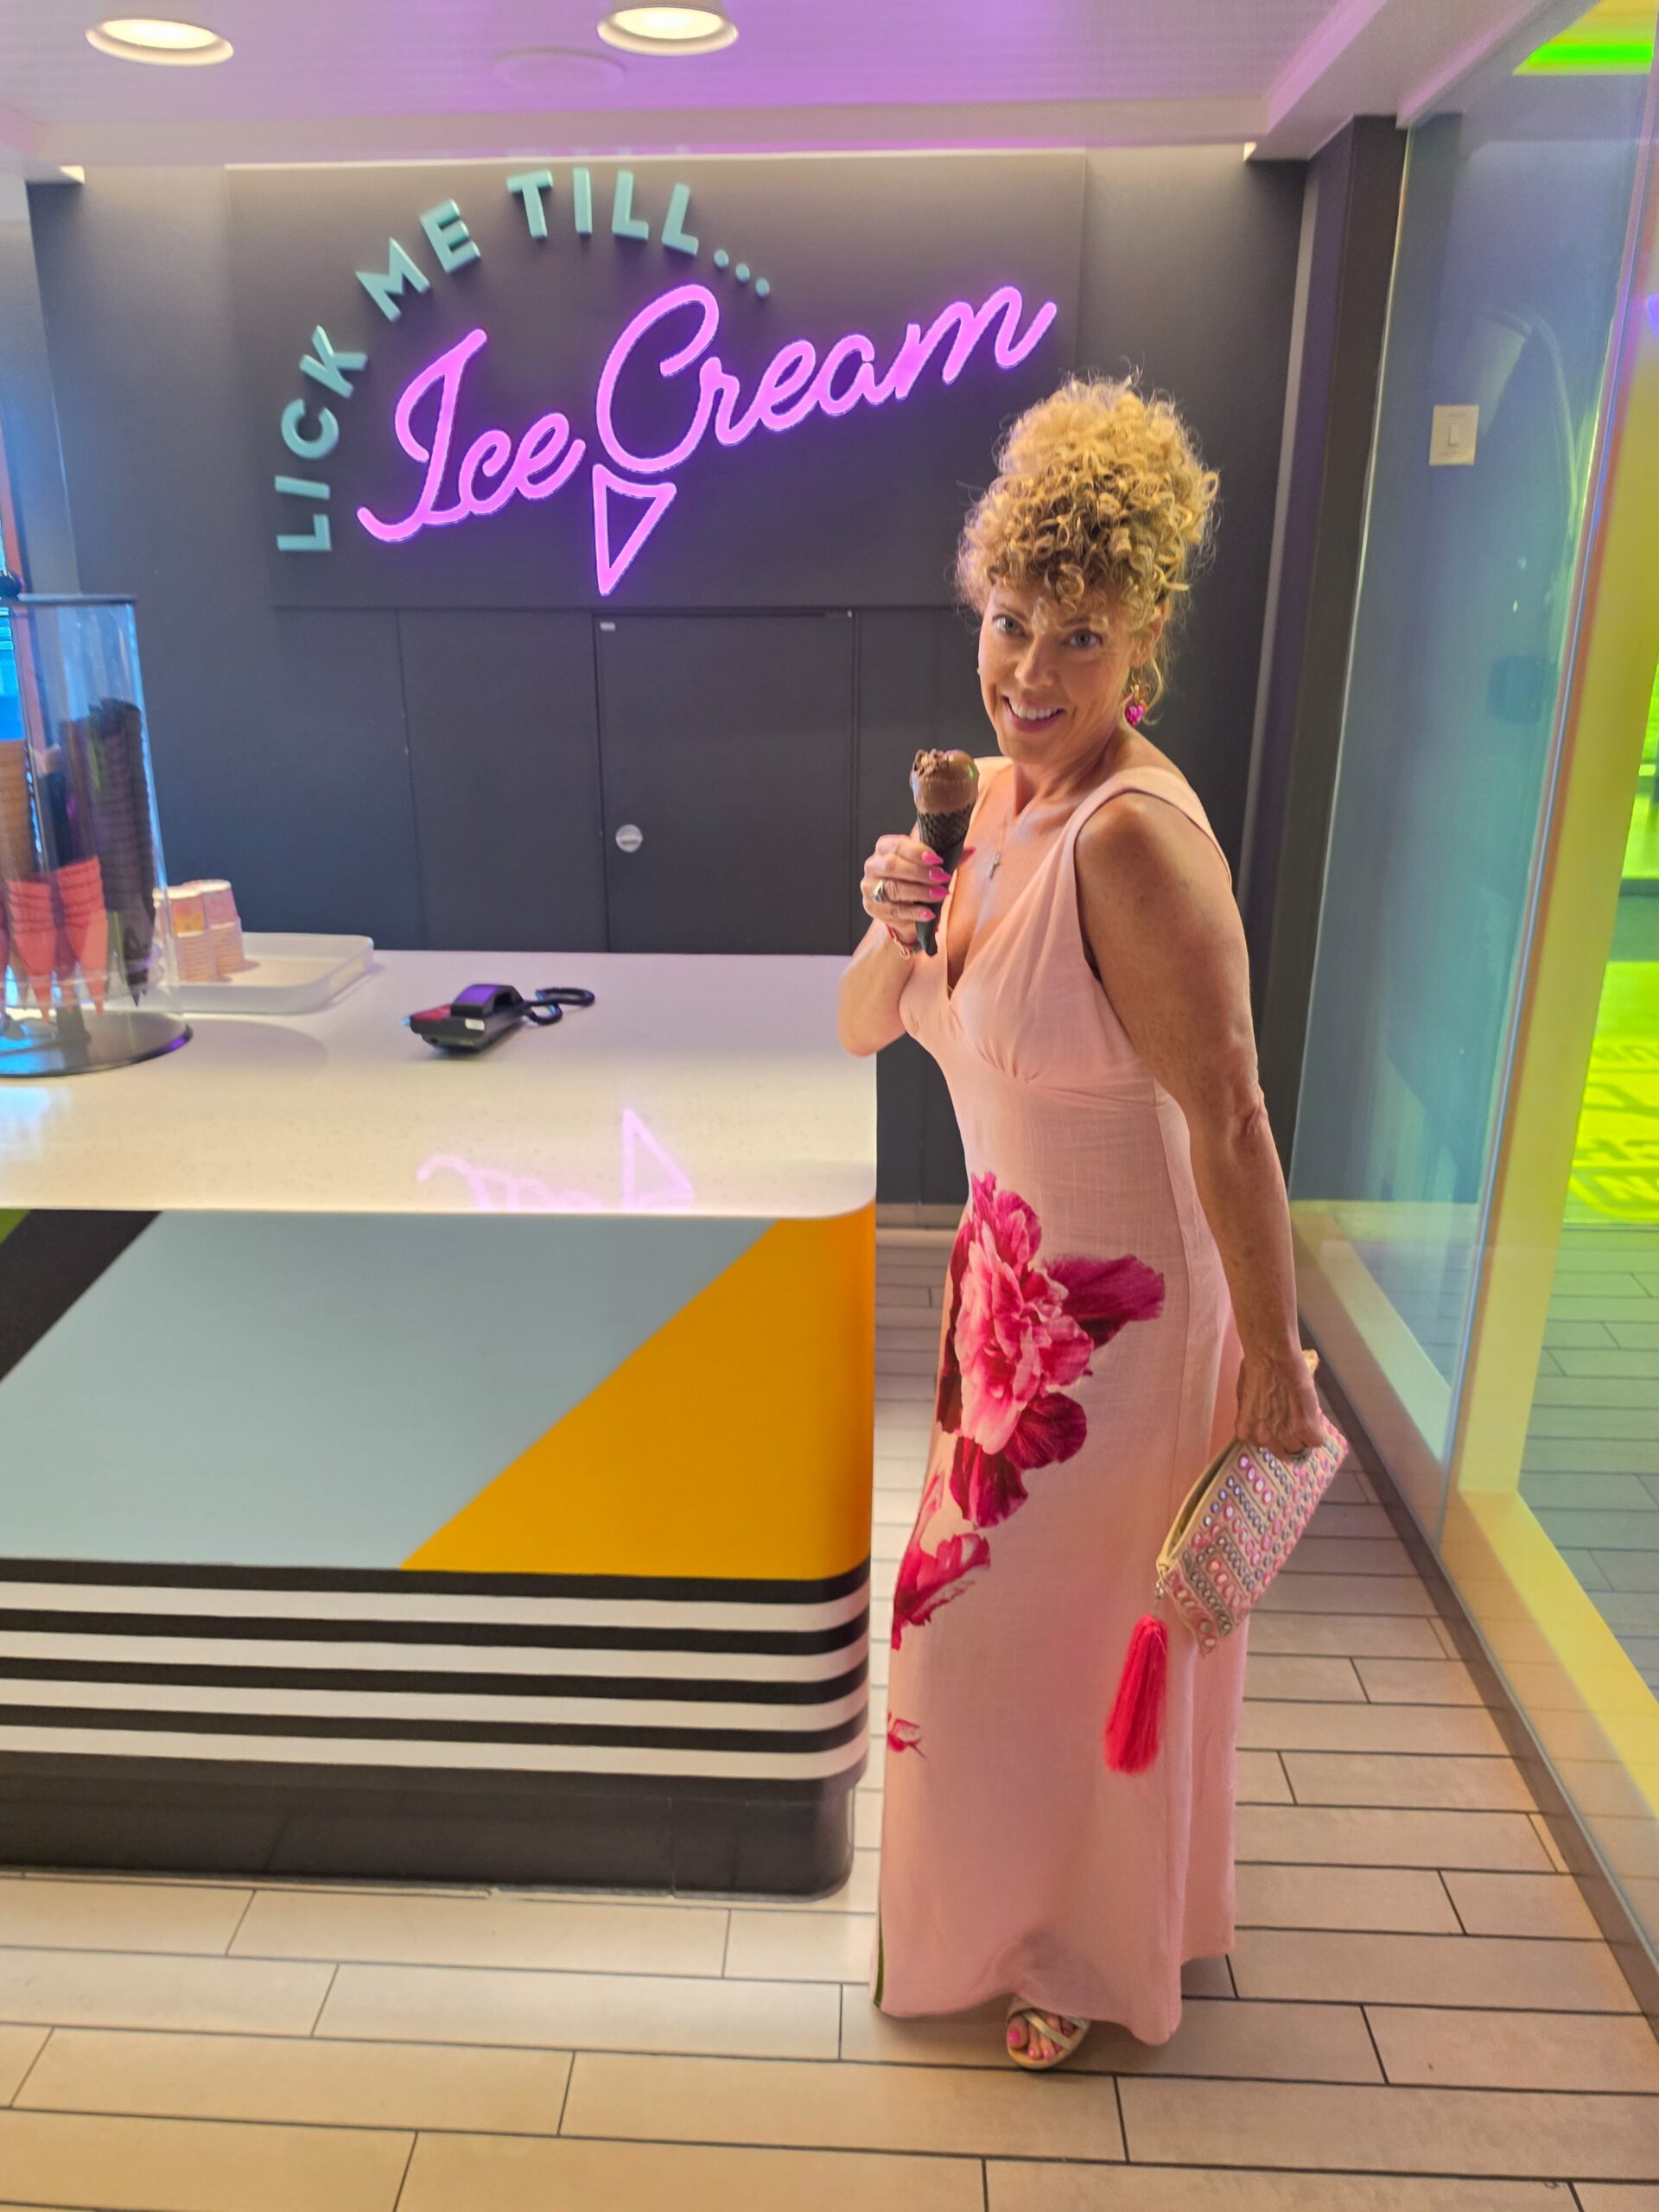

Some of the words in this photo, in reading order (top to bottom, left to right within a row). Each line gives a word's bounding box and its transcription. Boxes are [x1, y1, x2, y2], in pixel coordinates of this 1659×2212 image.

[275, 325, 368, 551] LICK
[355, 199, 480, 322] ME
[506, 167, 770, 297] TILL...
[357, 328, 587, 542] Ice
[595, 283, 1058, 474] Cream
